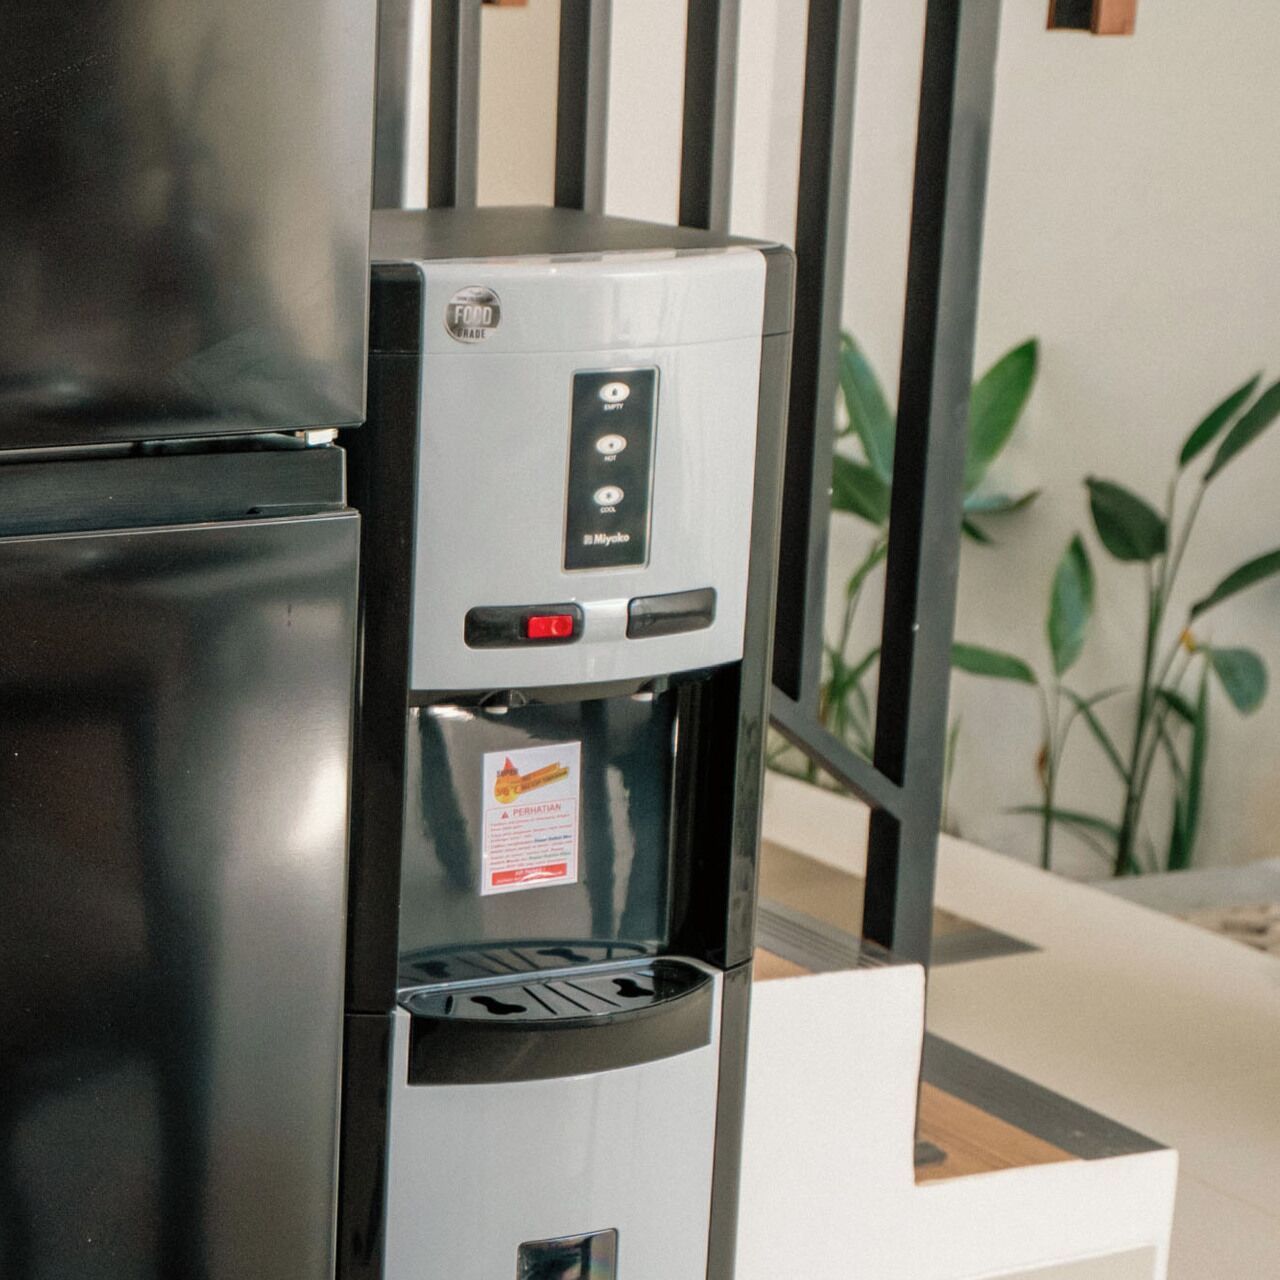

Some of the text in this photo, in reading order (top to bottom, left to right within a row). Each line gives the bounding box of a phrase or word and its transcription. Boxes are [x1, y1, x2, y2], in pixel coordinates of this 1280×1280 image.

[454, 305, 492, 325] FOOD
[593, 531, 630, 546] Miyako
[512, 803, 561, 817] PERHATIAN
